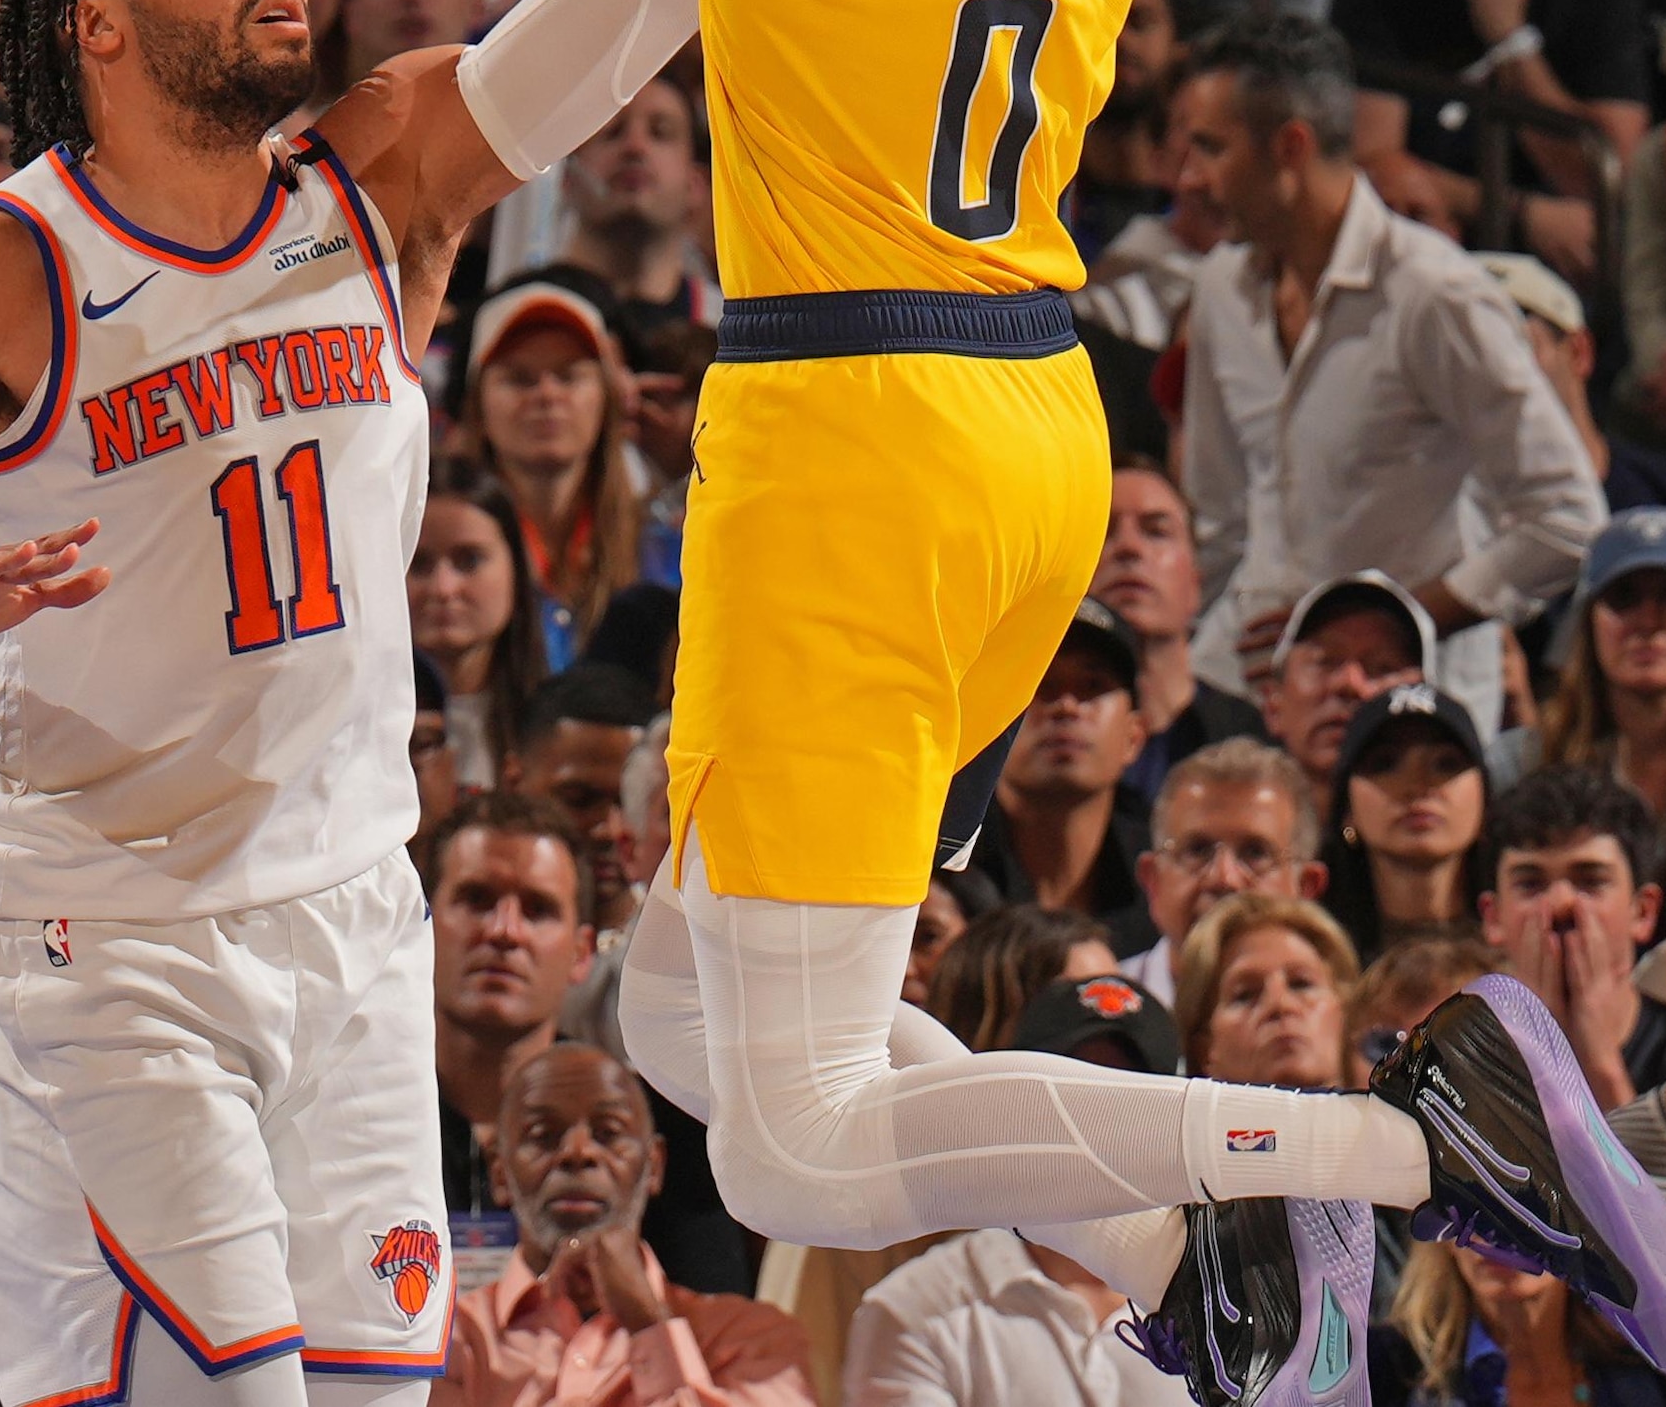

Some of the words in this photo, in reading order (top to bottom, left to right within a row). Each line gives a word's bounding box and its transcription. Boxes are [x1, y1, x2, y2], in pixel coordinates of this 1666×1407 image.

[274, 249, 309, 271] abu
[310, 232, 352, 259] dhabi
[80, 346, 235, 477] NEW
[234, 323, 392, 420] YORK
[209, 439, 346, 656] 11
[371, 1225, 440, 1276] KNICKS
